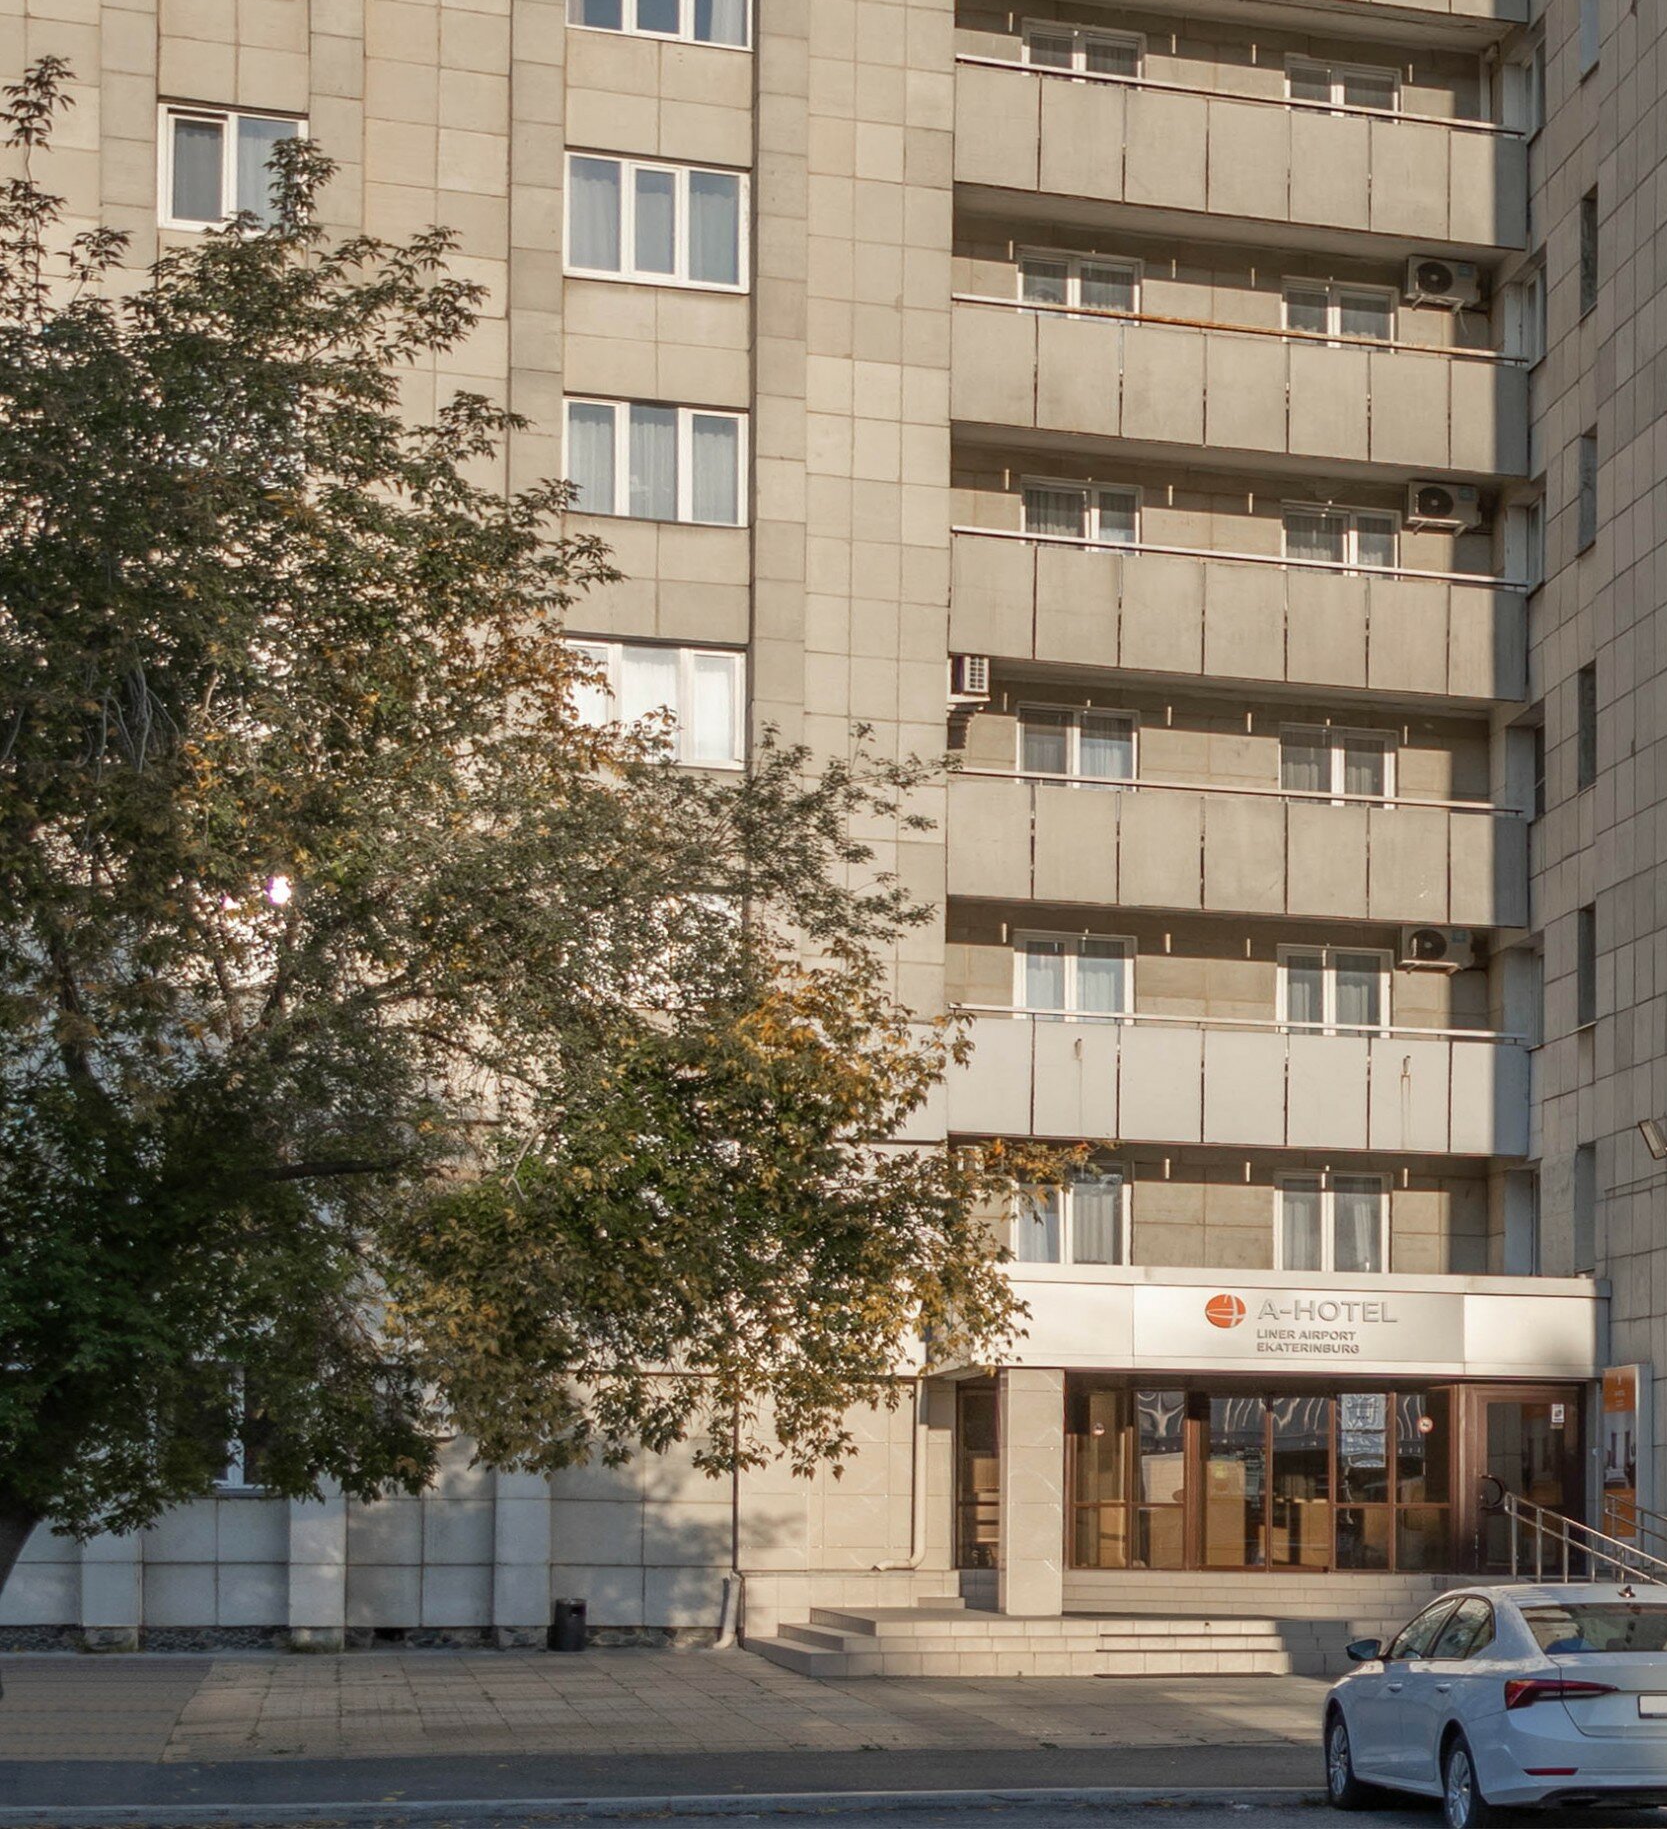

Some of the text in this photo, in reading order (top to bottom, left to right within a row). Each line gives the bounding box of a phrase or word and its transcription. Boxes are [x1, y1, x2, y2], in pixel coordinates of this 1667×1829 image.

[1257, 1298, 1398, 1323] A-HOTEL
[1256, 1328, 1357, 1341] LINER AIRPORT
[1256, 1342, 1360, 1354] EKATERINBURG
